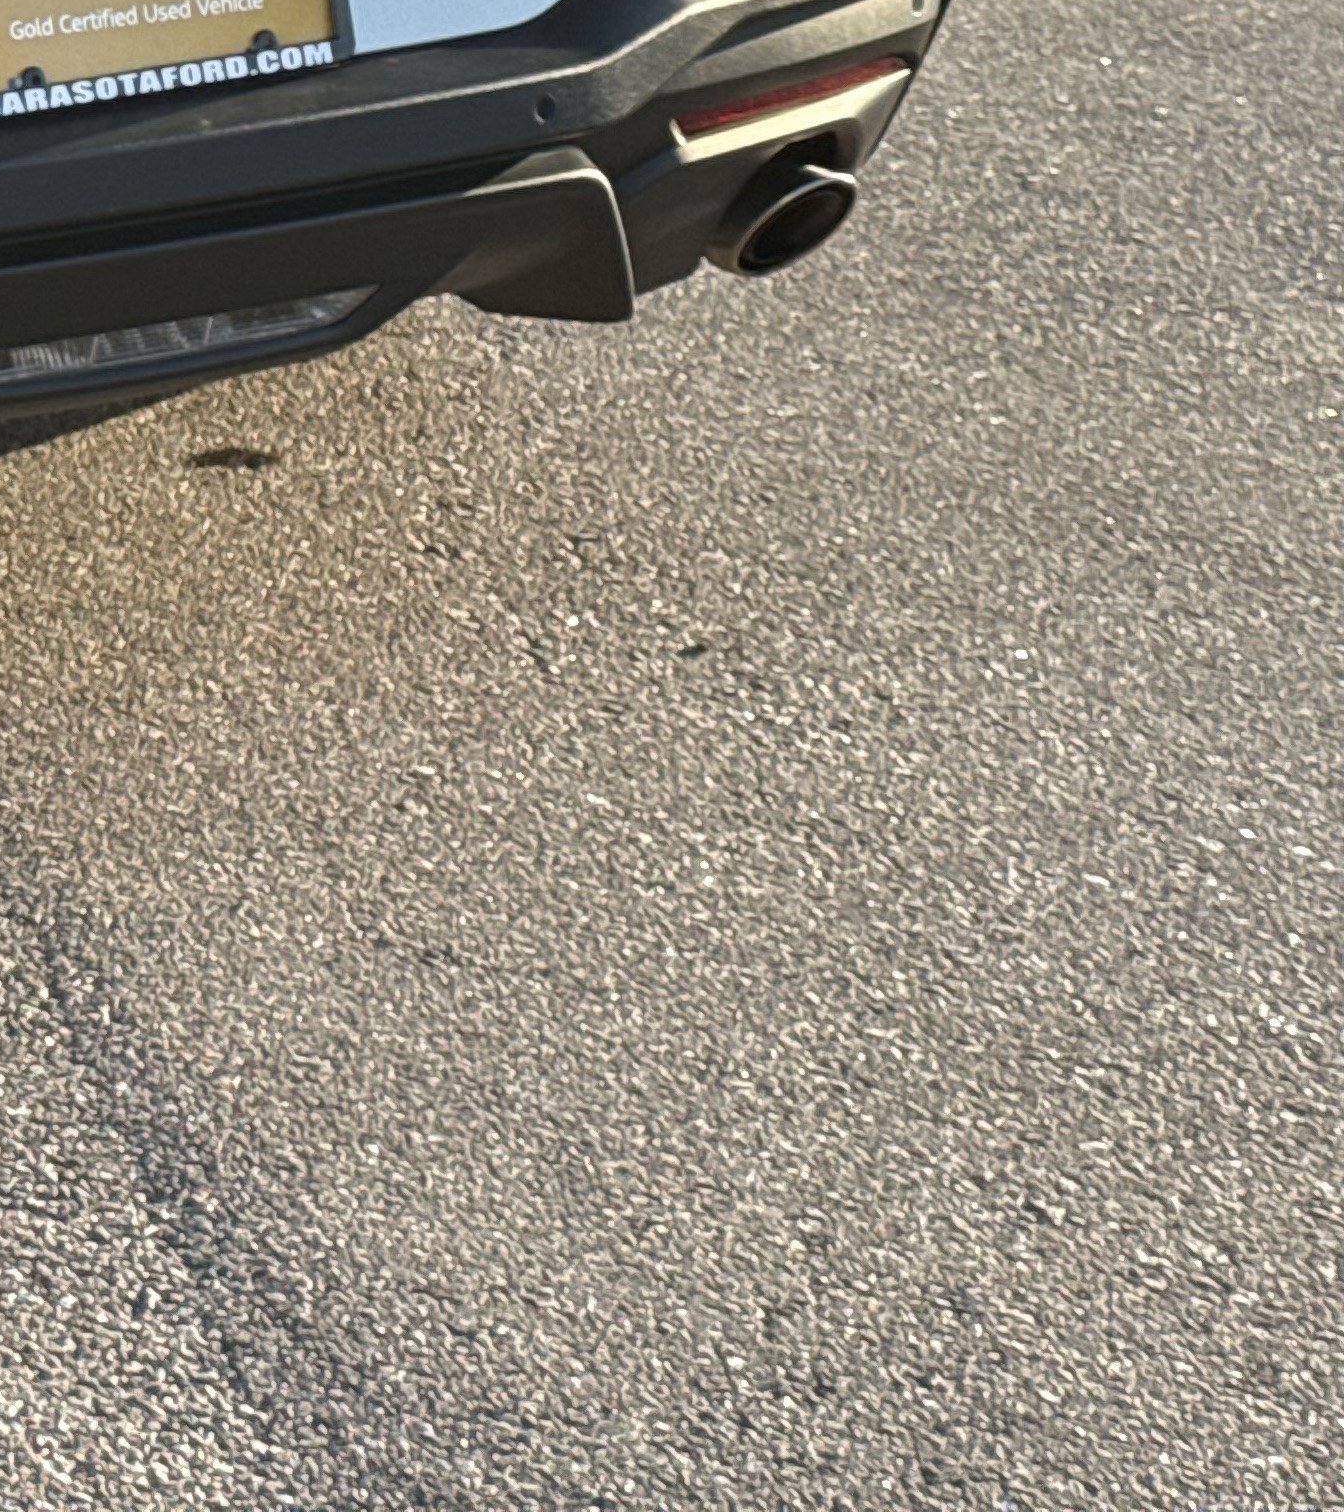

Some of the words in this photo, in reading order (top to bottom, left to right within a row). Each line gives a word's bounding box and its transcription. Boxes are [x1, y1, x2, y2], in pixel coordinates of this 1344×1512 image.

[9, 16, 54, 40] Gold
[59, 5, 139, 35] Certified
[143, 0, 191, 24] Used
